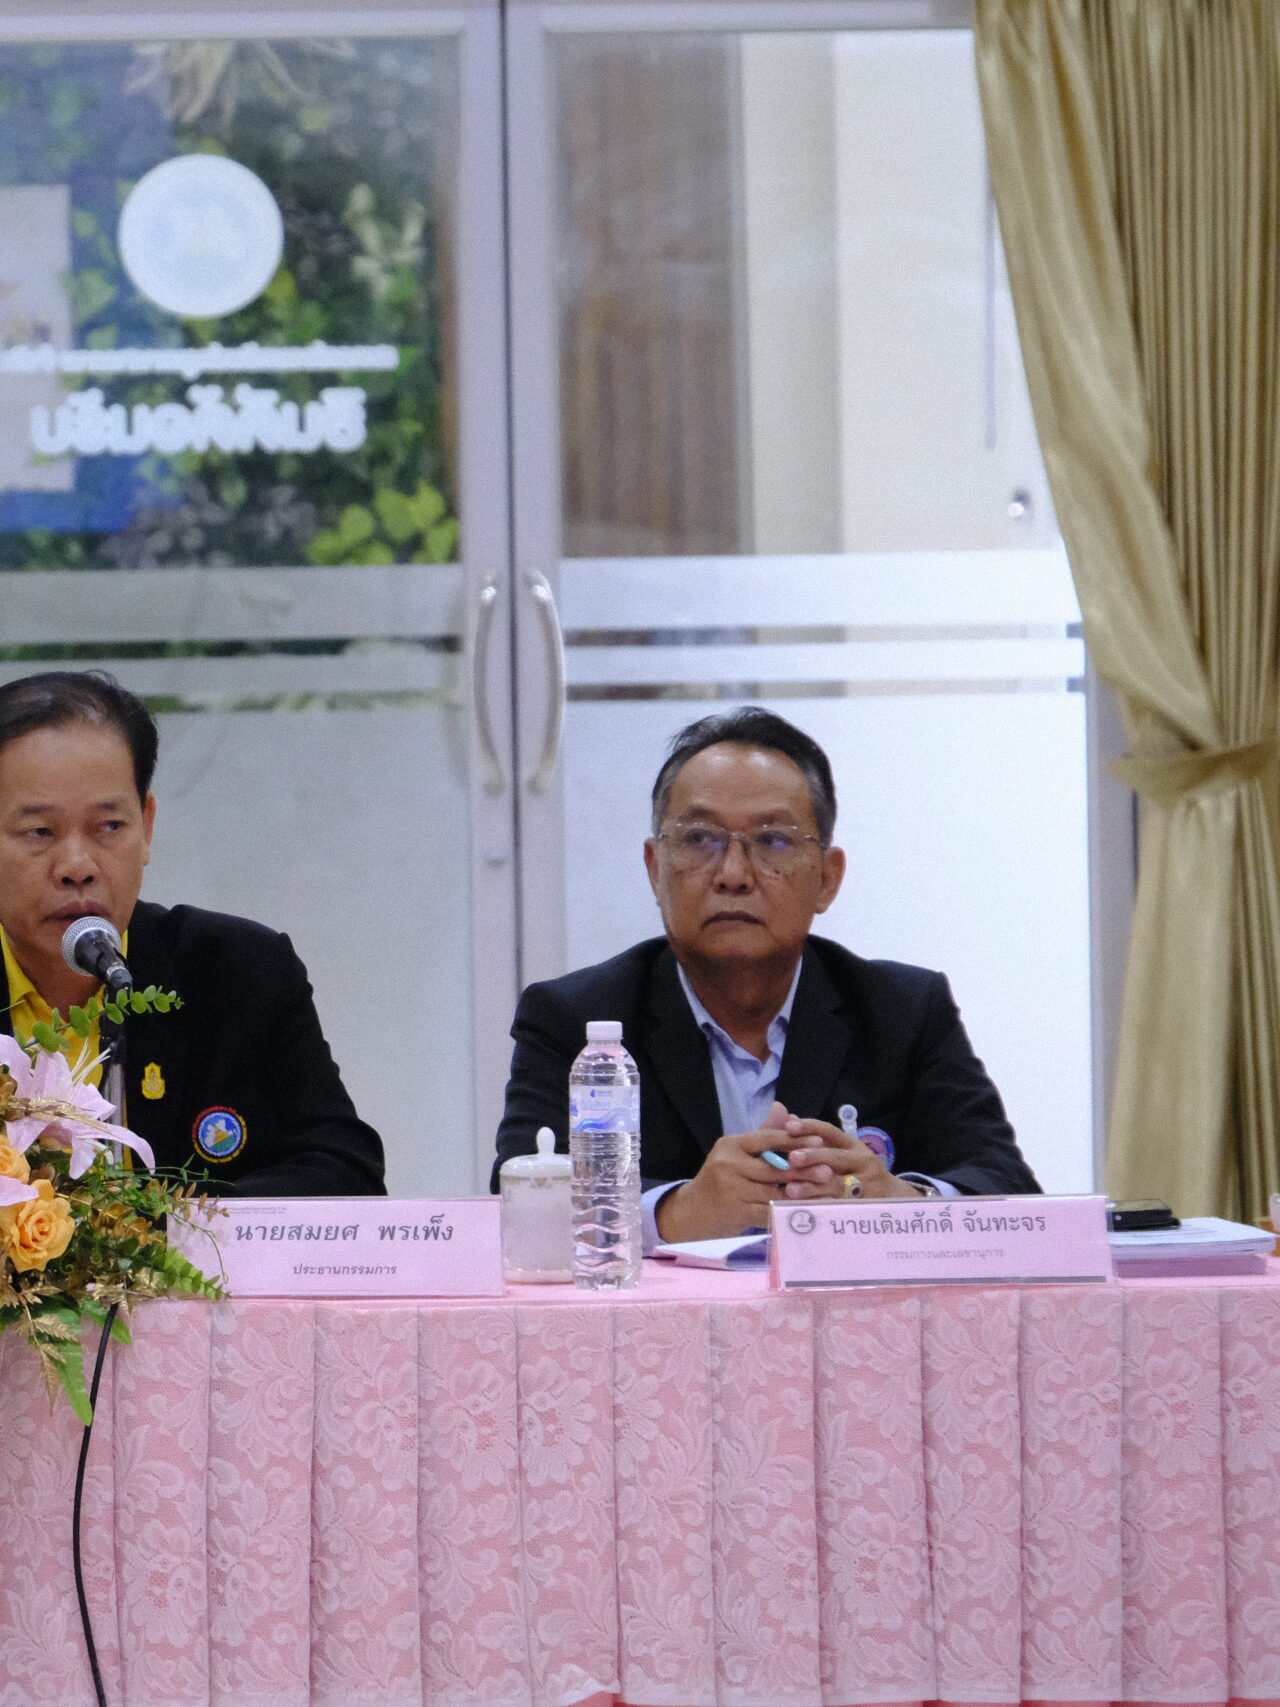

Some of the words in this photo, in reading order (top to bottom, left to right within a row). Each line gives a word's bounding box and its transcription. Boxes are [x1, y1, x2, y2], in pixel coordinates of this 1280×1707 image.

[235, 1222, 359, 1241] นายสมยศ
[378, 1213, 454, 1241] พรเพ็ง
[963, 1209, 1046, 1233] จันทะจร
[292, 1262, 398, 1276] ประธานกรรมการ
